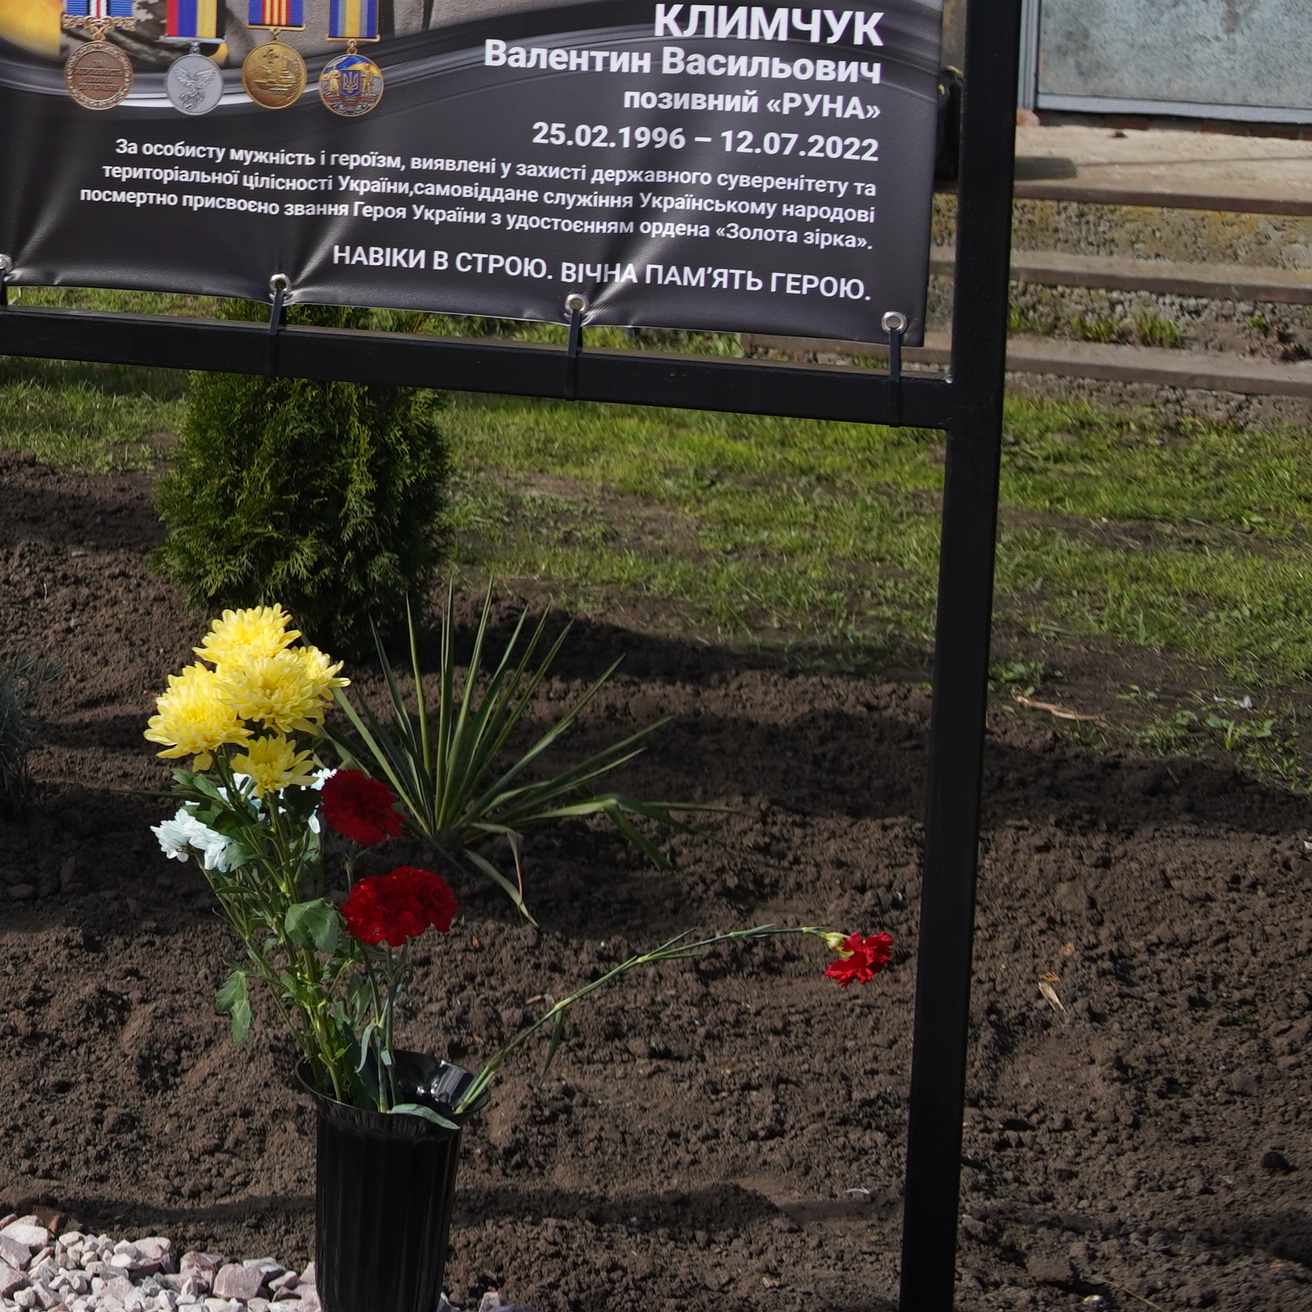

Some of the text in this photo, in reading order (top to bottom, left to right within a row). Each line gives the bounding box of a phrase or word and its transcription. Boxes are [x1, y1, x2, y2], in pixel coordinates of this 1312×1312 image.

[654, 3, 885, 46] КЛИМЧУК
[484, 39, 882, 84] Валентин Васильович
[624, 89, 881, 120] позивний «РУНА»
[532, 121, 686, 149] 25.02.1996
[721, 130, 879, 162] 12.07.2022
[115, 138, 876, 198] За особисту мужність і героїзм, виявлені у захисті державного суверенітету та
[80, 189, 873, 250] посмертно присвоєно звання Героя України з удостоєнням ордена «Золота зірка».
[102, 165, 238, 185] територіальної
[242, 172, 333, 191] цілісності
[543, 191, 633, 210] служіння
[639, 192, 778, 219] Українському
[782, 203, 875, 224] народові
[333, 245, 426, 269] НАВІКИ
[432, 250, 449, 270] В
[455, 252, 553, 280] СТРОЮ.
[561, 261, 638, 284] ВІЧНА
[770, 272, 871, 301] ГЕРОЮ.
